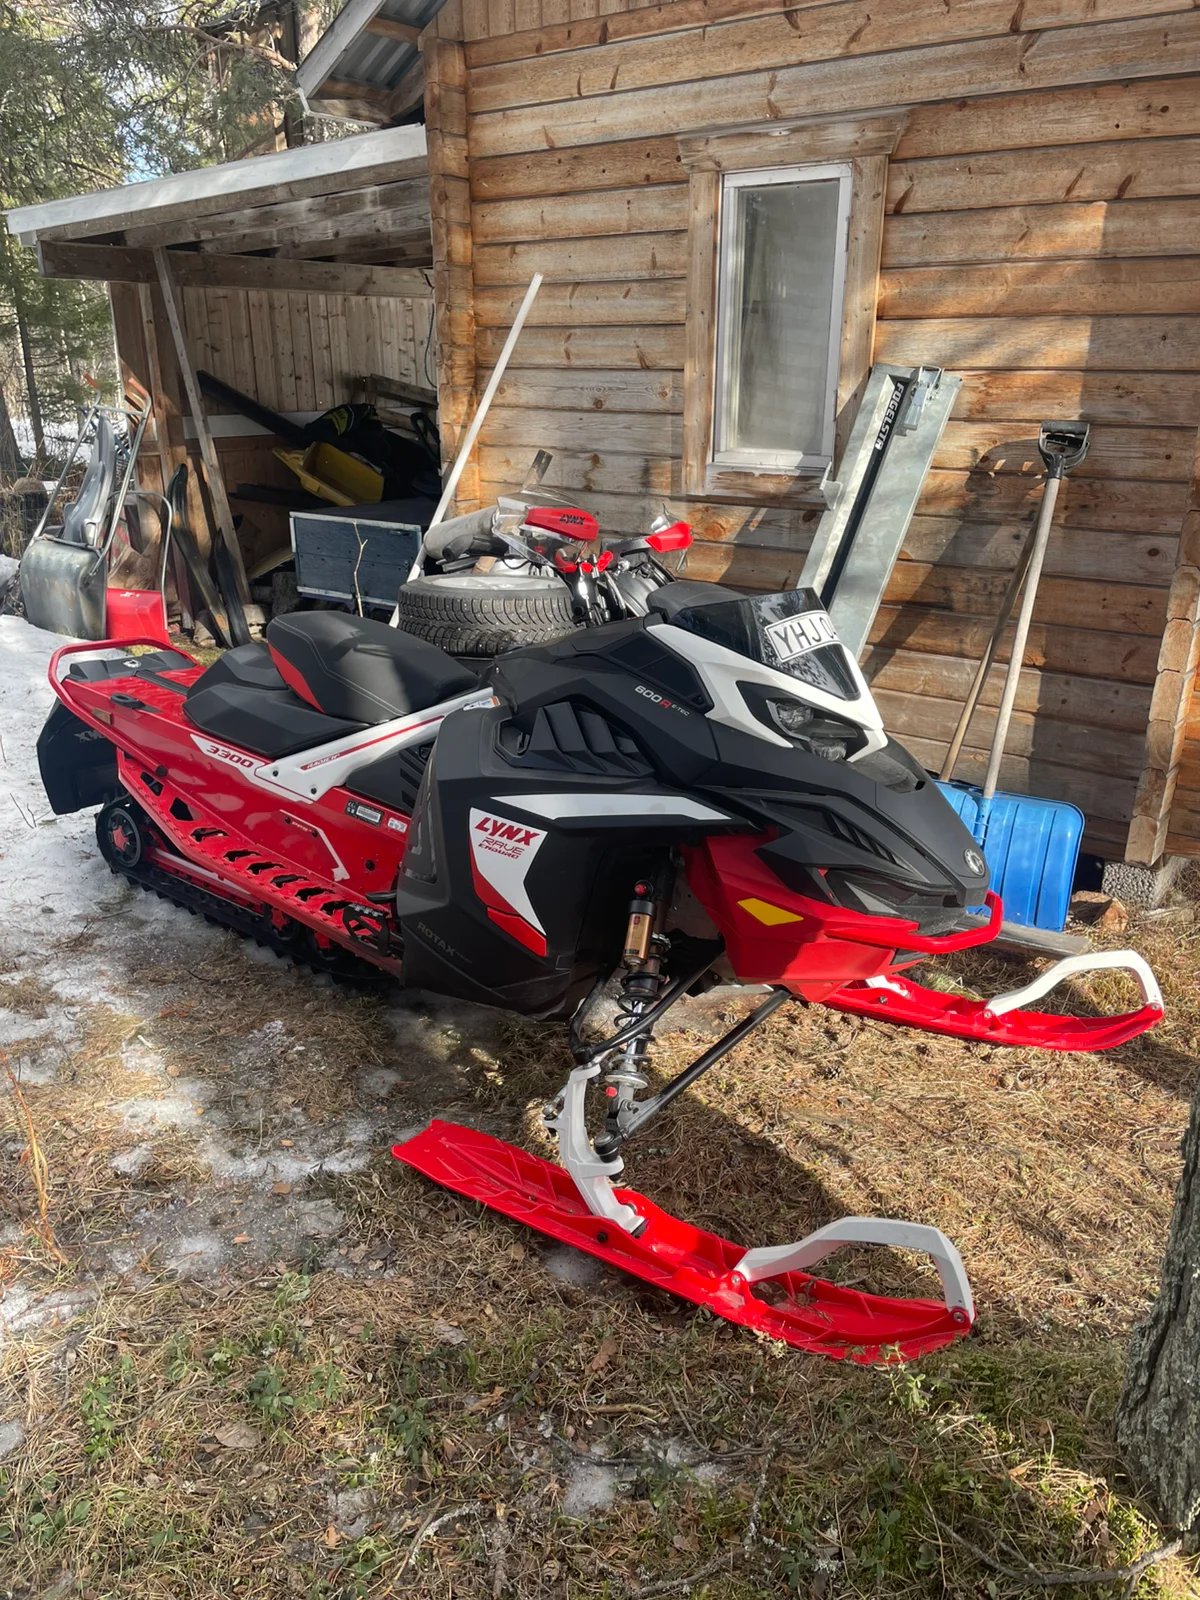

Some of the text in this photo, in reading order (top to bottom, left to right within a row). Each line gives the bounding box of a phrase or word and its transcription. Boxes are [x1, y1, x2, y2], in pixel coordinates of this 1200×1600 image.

[874, 382, 905, 451] FOGELSTA
[559, 513, 586, 526] LYNX
[773, 618, 823, 654] YHJ
[206, 744, 254, 769] 3300
[474, 816, 541, 847] LYNX
[477, 843, 520, 860] ENDURO
[481, 836, 526, 856] RAVE
[416, 921, 457, 957] ROTAX
